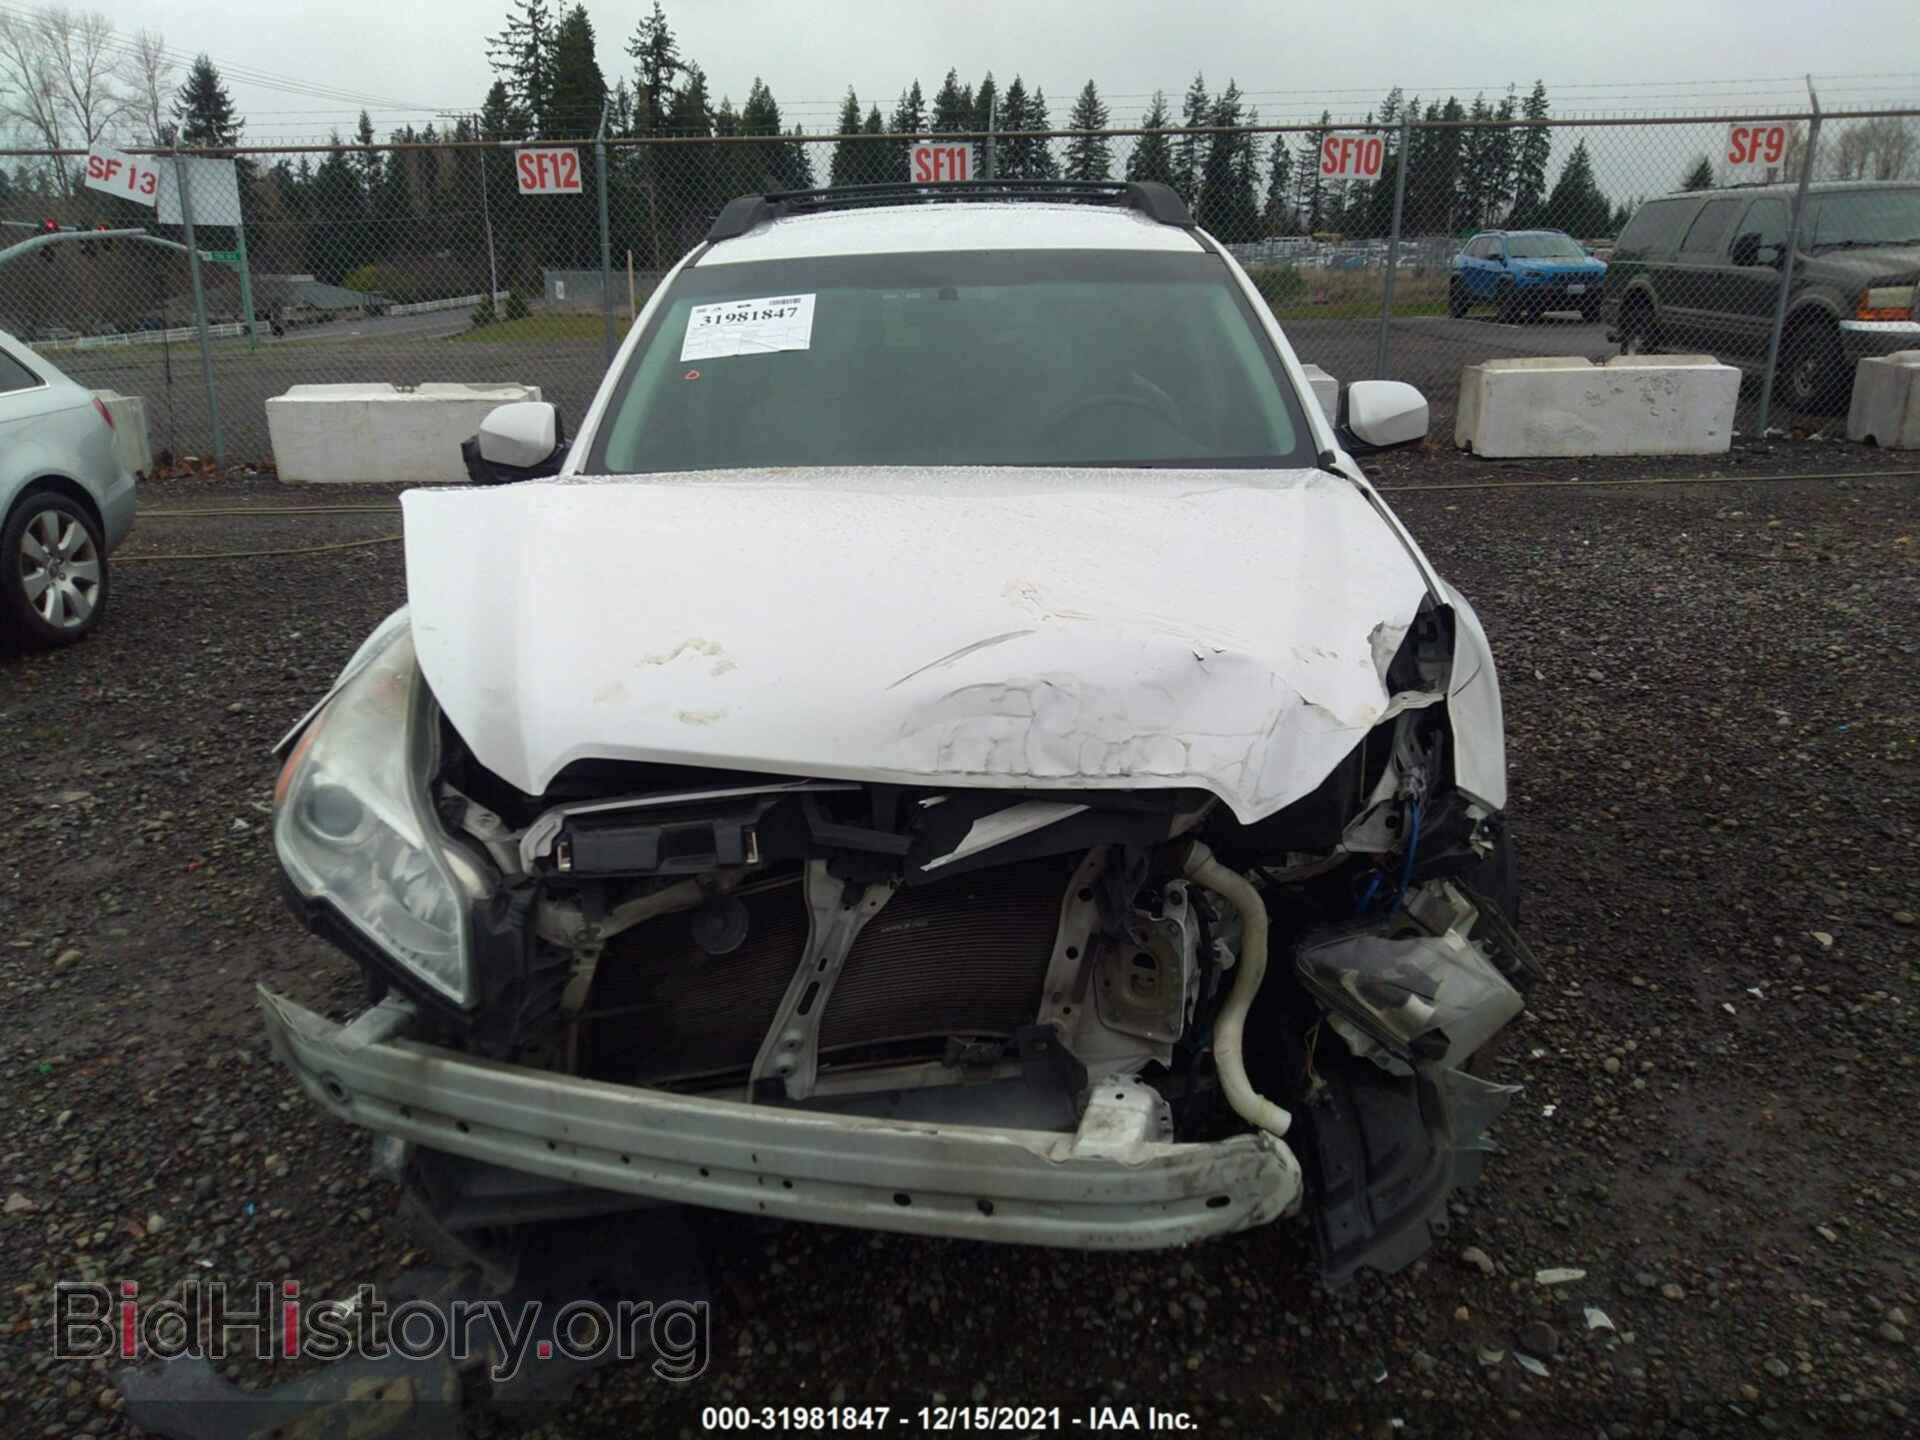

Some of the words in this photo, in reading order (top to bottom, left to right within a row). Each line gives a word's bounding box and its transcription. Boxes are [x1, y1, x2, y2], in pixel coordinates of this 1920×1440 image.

[915, 147, 966, 183] SF11
[1322, 137, 1382, 175] SF10
[1728, 127, 1784, 165] SF9
[88, 154, 122, 182] SF
[128, 163, 156, 194] 13
[518, 152, 579, 190] SF12
[700, 306, 799, 326] 31981847
